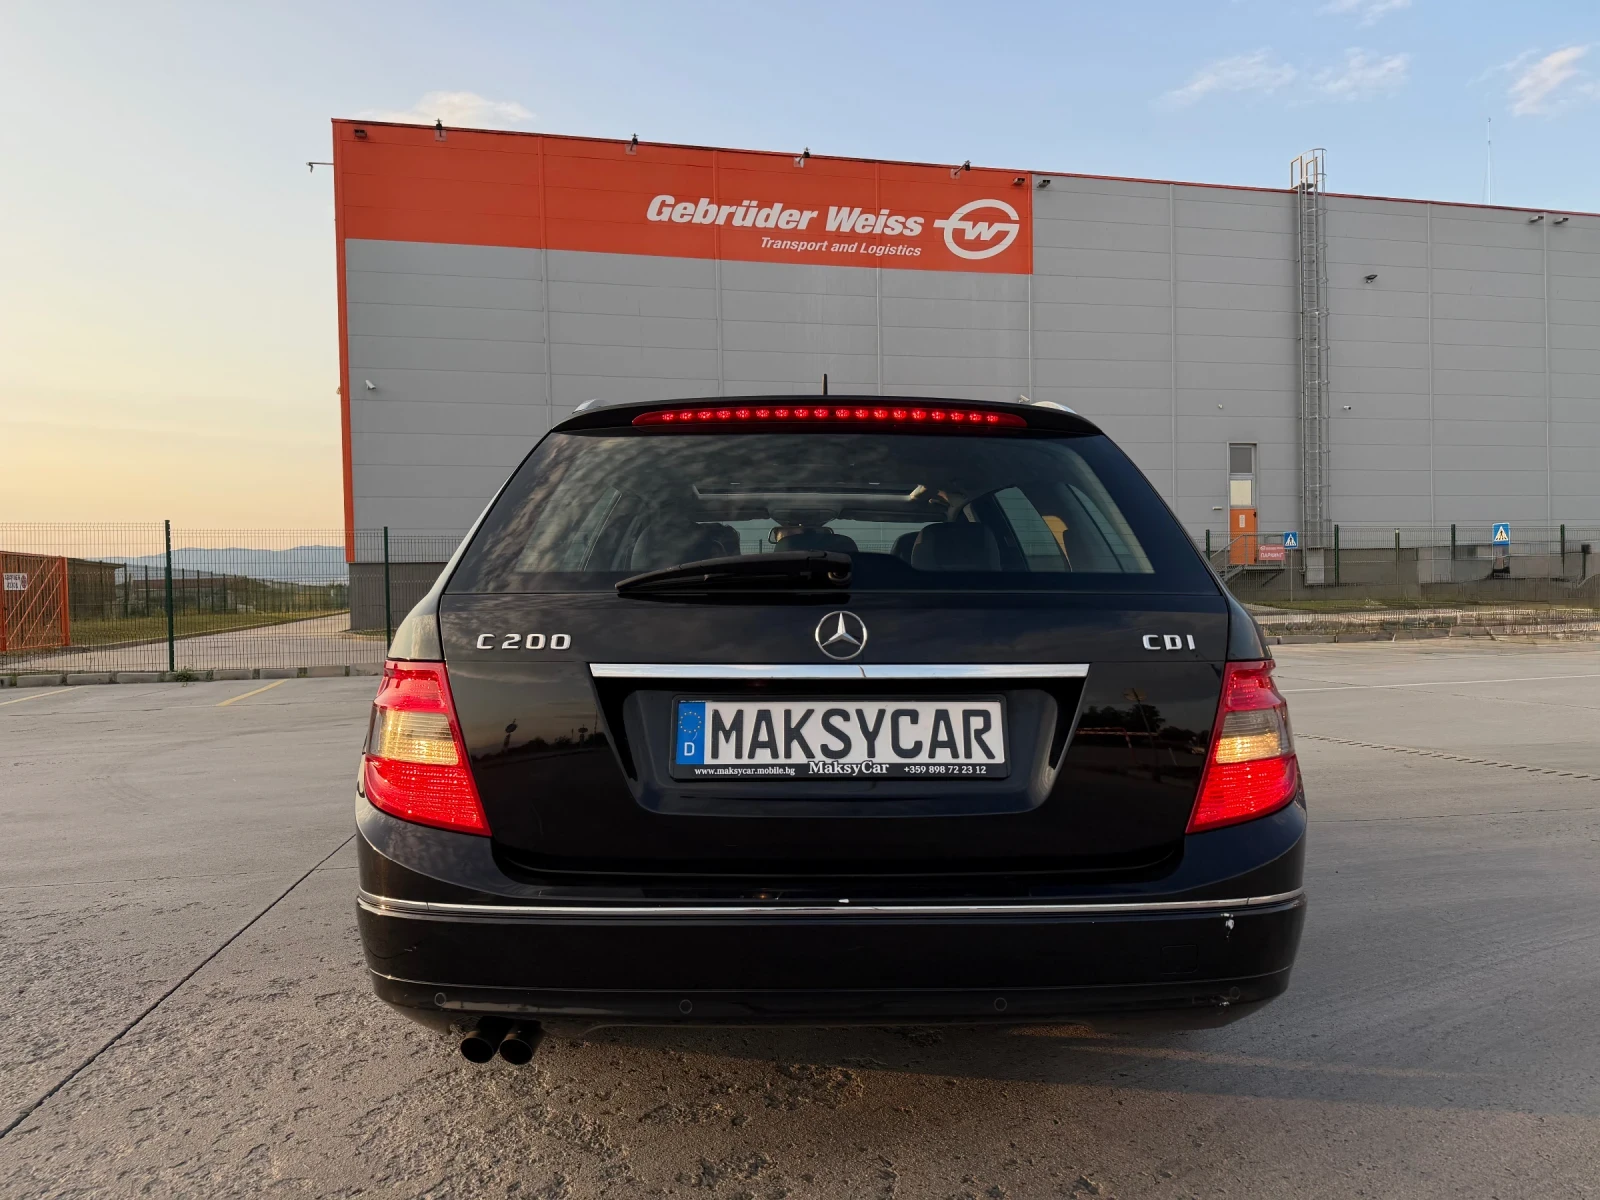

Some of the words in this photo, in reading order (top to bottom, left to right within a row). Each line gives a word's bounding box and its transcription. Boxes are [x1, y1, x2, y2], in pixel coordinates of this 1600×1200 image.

[646, 194, 818, 230] Gebrüder
[825, 206, 925, 236] Weiss
[760, 236, 828, 252] Transport
[831, 241, 857, 253] and
[860, 242, 922, 257] Logistics
[476, 633, 496, 650] C
[501, 633, 571, 650] 200
[1142, 634, 1196, 650] CDI
[711, 708, 996, 760] MAKSYCAR
[684, 741, 695, 756] D
[694, 766, 796, 776] www.maksycar.mobile.bg
[808, 761, 890, 776] MaksyCar
[903, 765, 926, 774] +359
[928, 765, 946, 774] 898
[948, 765, 959, 774] 72
[961, 765, 973, 774] 23
[975, 765, 987, 774] 12
